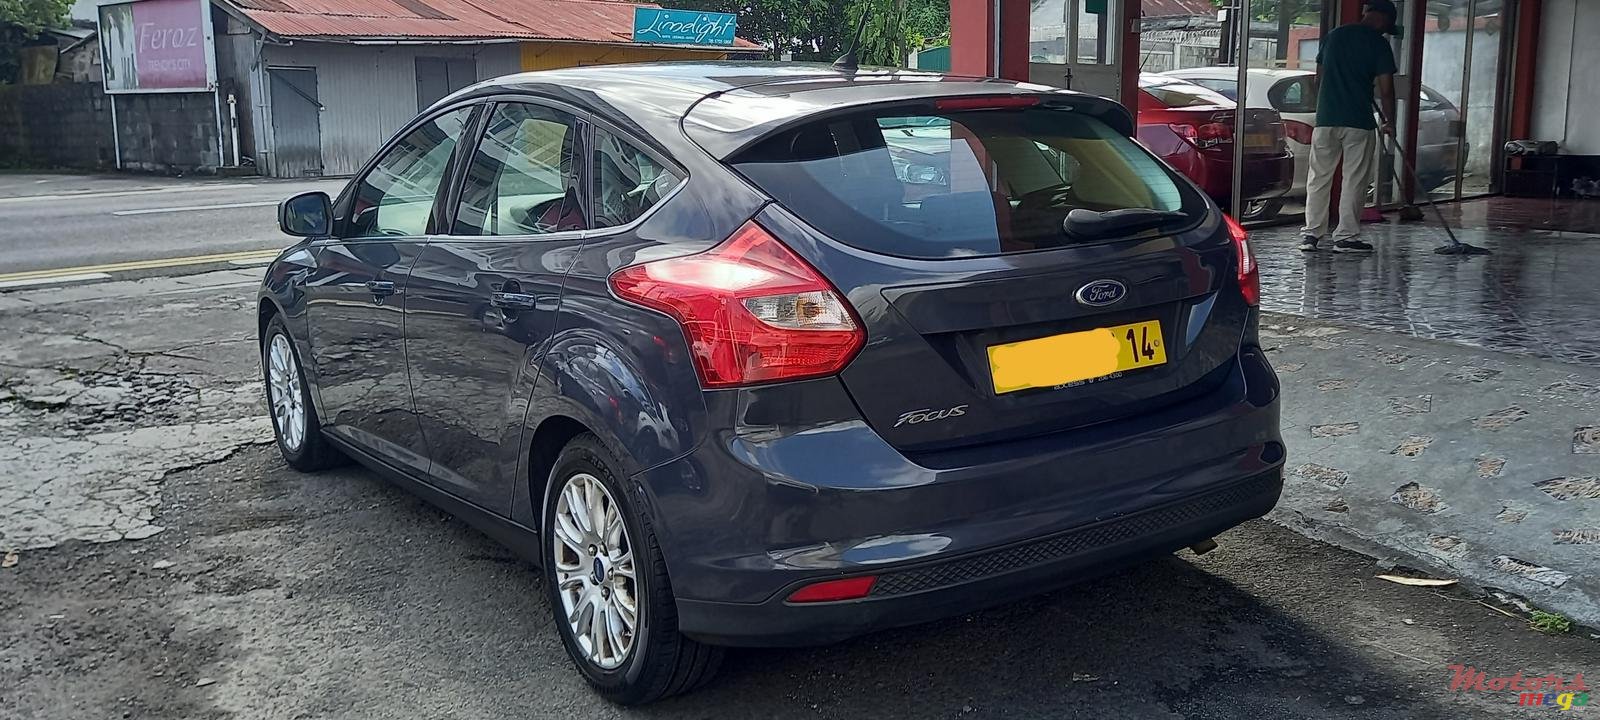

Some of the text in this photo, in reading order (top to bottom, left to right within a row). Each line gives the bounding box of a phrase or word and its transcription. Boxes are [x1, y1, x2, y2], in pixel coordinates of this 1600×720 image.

[637, 11, 735, 43] Limelight
[1090, 284, 1117, 301] Ford
[1126, 326, 1155, 363] 14
